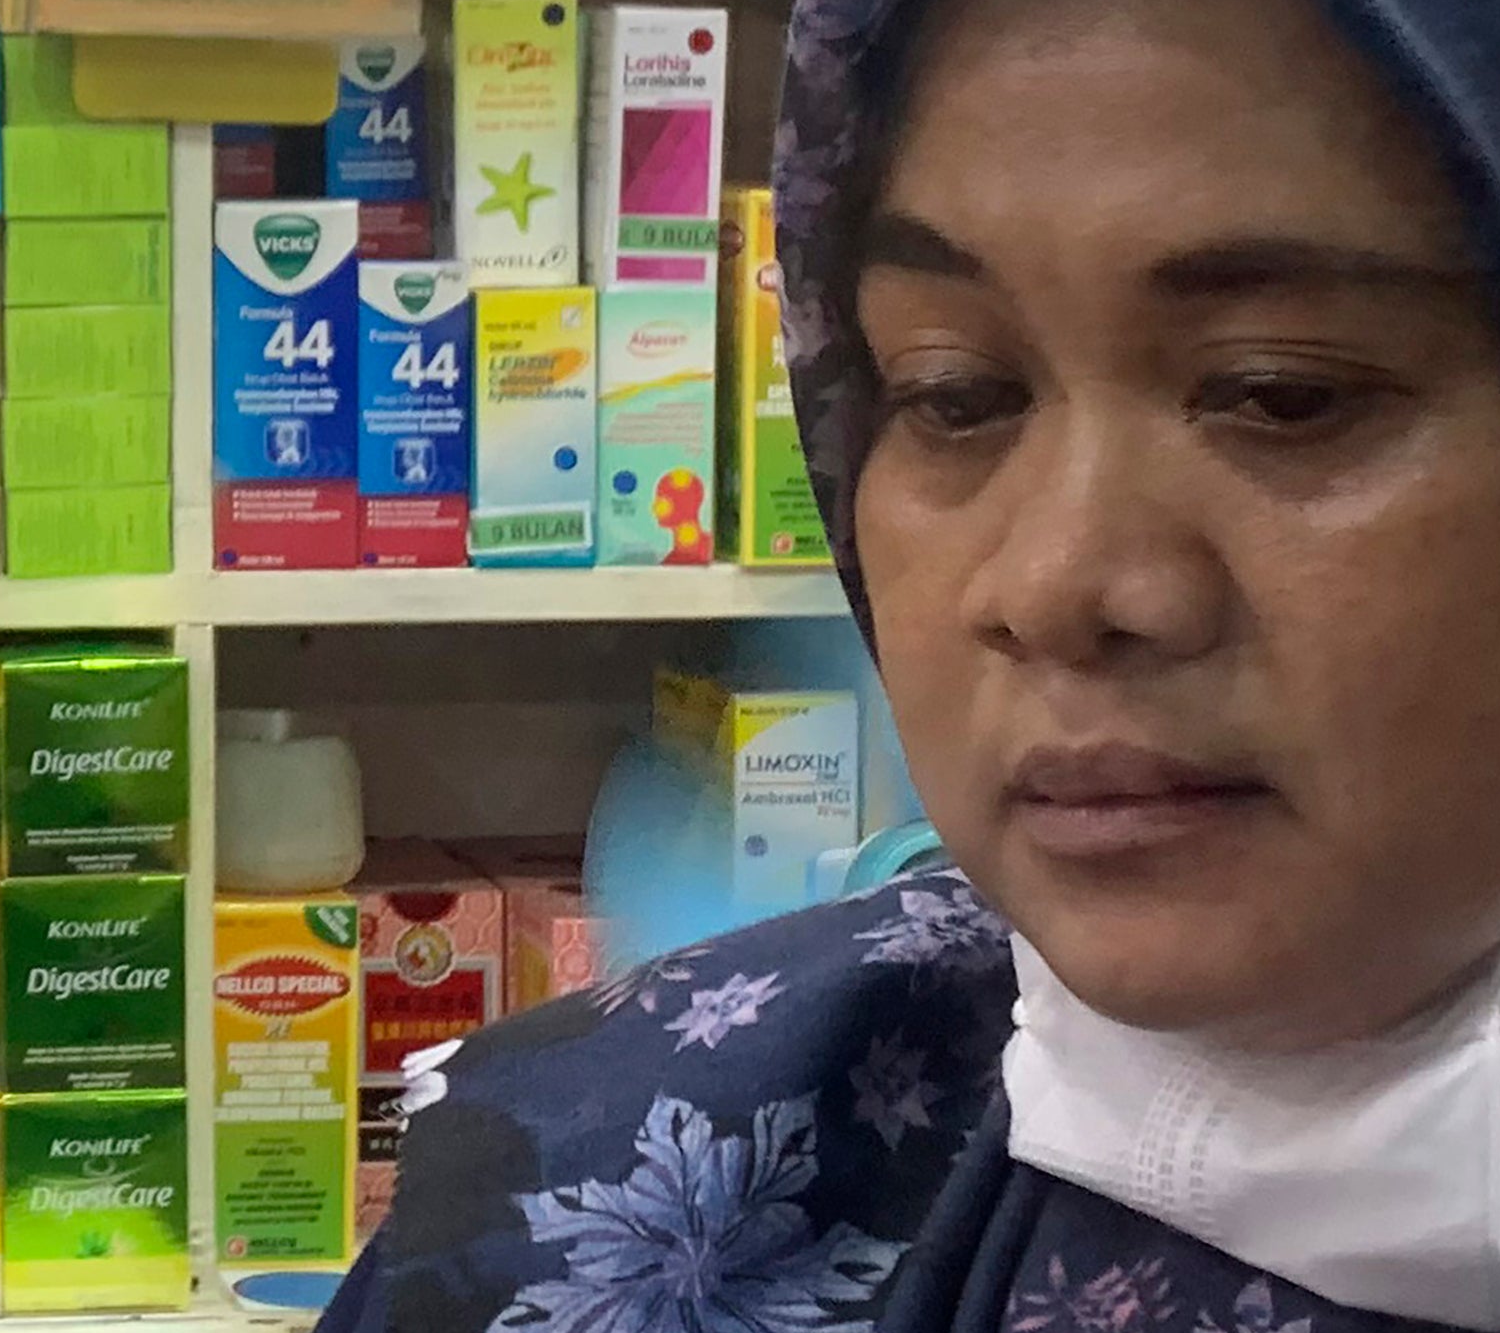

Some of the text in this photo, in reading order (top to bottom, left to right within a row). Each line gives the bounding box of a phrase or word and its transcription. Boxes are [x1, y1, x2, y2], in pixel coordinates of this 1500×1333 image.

[358, 106, 412, 143] 44
[258, 232, 316, 252] VICKS
[263, 319, 334, 368] 44
[392, 343, 460, 390] 44
[508, 518, 585, 540] BULAN
[30, 747, 173, 778] DigestCare
[745, 753, 840, 774] LIMOXIN
[27, 965, 170, 998] DigestCare
[277, 974, 344, 996] SPECIAL
